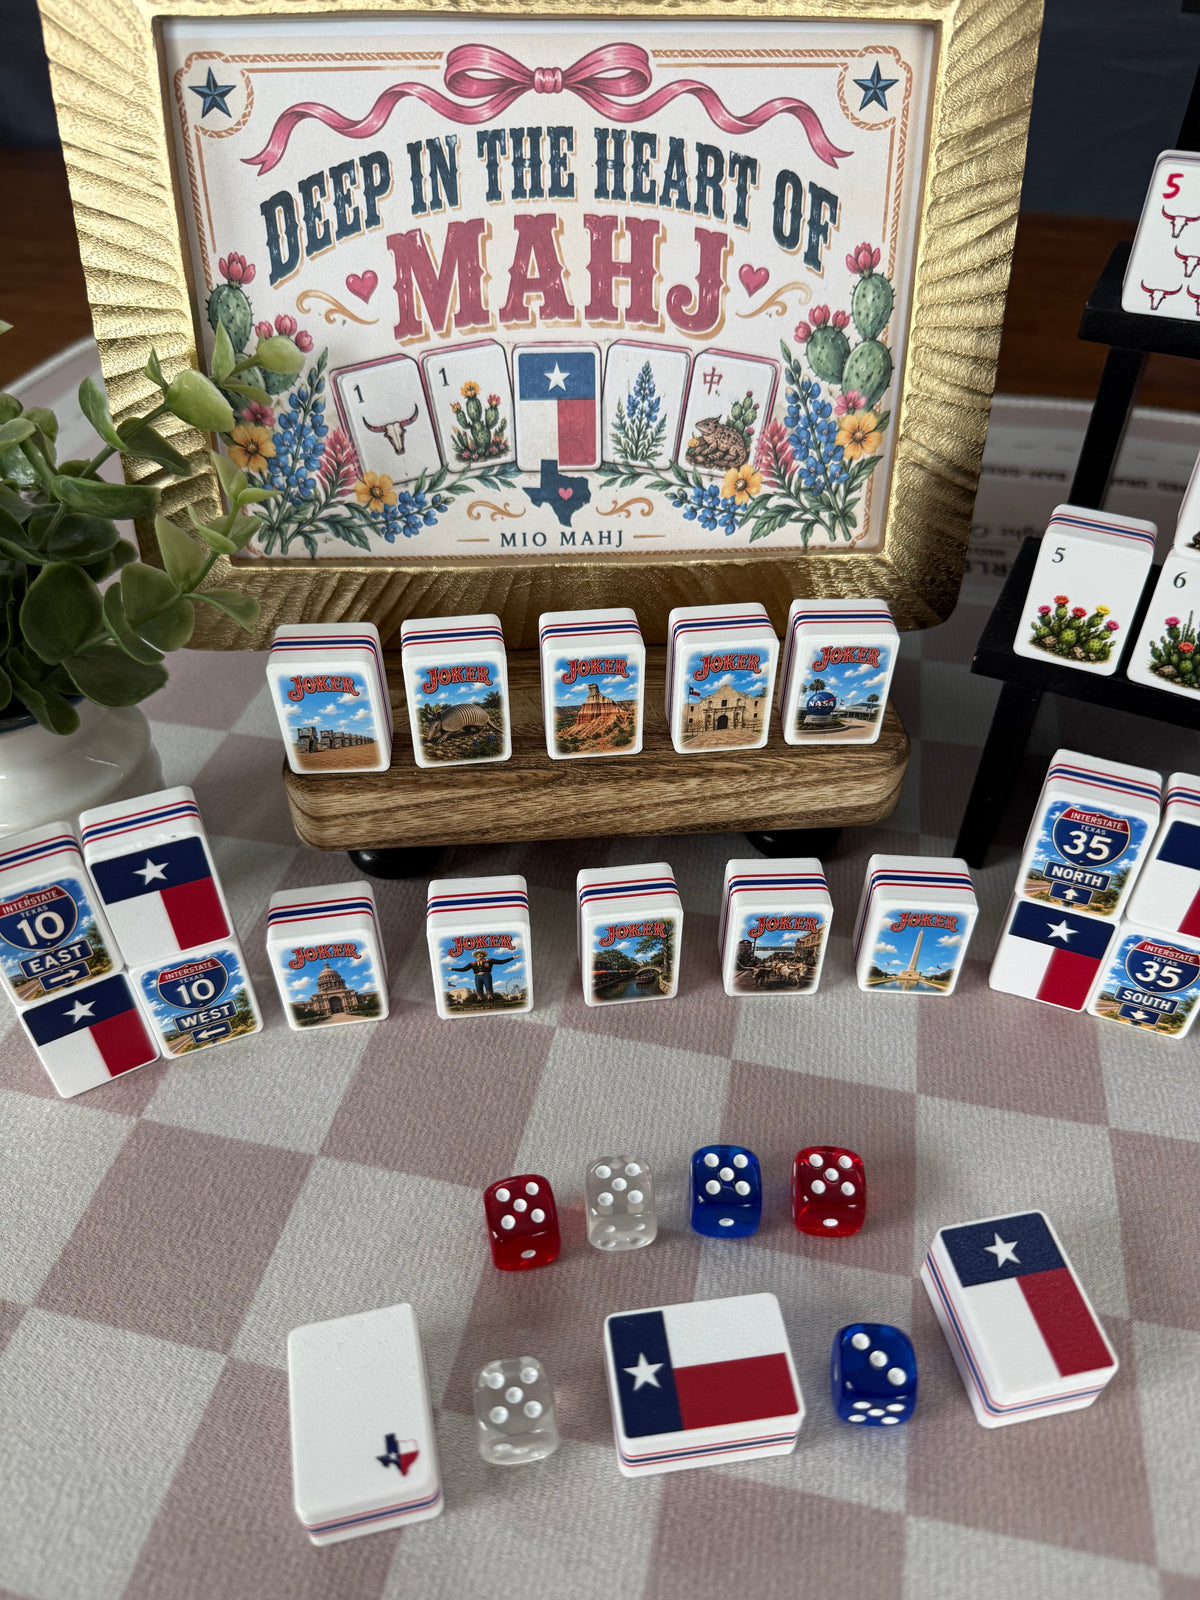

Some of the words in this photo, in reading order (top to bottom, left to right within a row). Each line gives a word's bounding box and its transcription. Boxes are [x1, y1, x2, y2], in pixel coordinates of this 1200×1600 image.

[1163, 173, 1184, 199] 5
[259, 150, 391, 287] DEEP
[407, 135, 461, 216] IN
[477, 125, 577, 202] THE
[592, 127, 758, 230] HEART
[772, 168, 842, 274] OF
[387, 213, 732, 341] MAHJ
[438, 367, 450, 387] 1
[703, 366, 723, 395] 中
[353, 384, 365, 404] 1
[500, 532, 547, 548] MIO
[559, 530, 623, 548] MAHJ
[1051, 547, 1067, 563] 5
[1172, 571, 1188, 589] 6
[561, 658, 630, 684] JOKER
[693, 653, 762, 681] JOKER
[812, 646, 881, 672] JOKER
[287, 675, 360, 702] JOKER
[422, 665, 493, 694] JOKER
[1070, 811, 1124, 830] INTERSTATE
[1080, 824, 1106, 835] TEXAS
[1063, 830, 1113, 861] 35
[1051, 865, 1103, 887] NORTH
[2, 890, 58, 915] INTERSTATE
[20, 904, 49, 918] TEXAS
[17, 911, 65, 946] 10
[747, 914, 820, 938] JOKER
[888, 911, 959, 932] JOKER
[448, 934, 516, 958] JOKER
[599, 921, 668, 948] JOKER
[29, 944, 83, 974] EAST
[289, 943, 361, 970] JOKER
[1144, 943, 1195, 963] INTERSTATE
[1152, 956, 1178, 967] TEXAS
[164, 961, 213, 981] INTERSTATE
[179, 973, 205, 984] TEXAS
[1135, 961, 1182, 988] 35
[176, 978, 215, 1005] 10
[1122, 990, 1172, 1011] SOUTH
[181, 1005, 231, 1028] WEST
